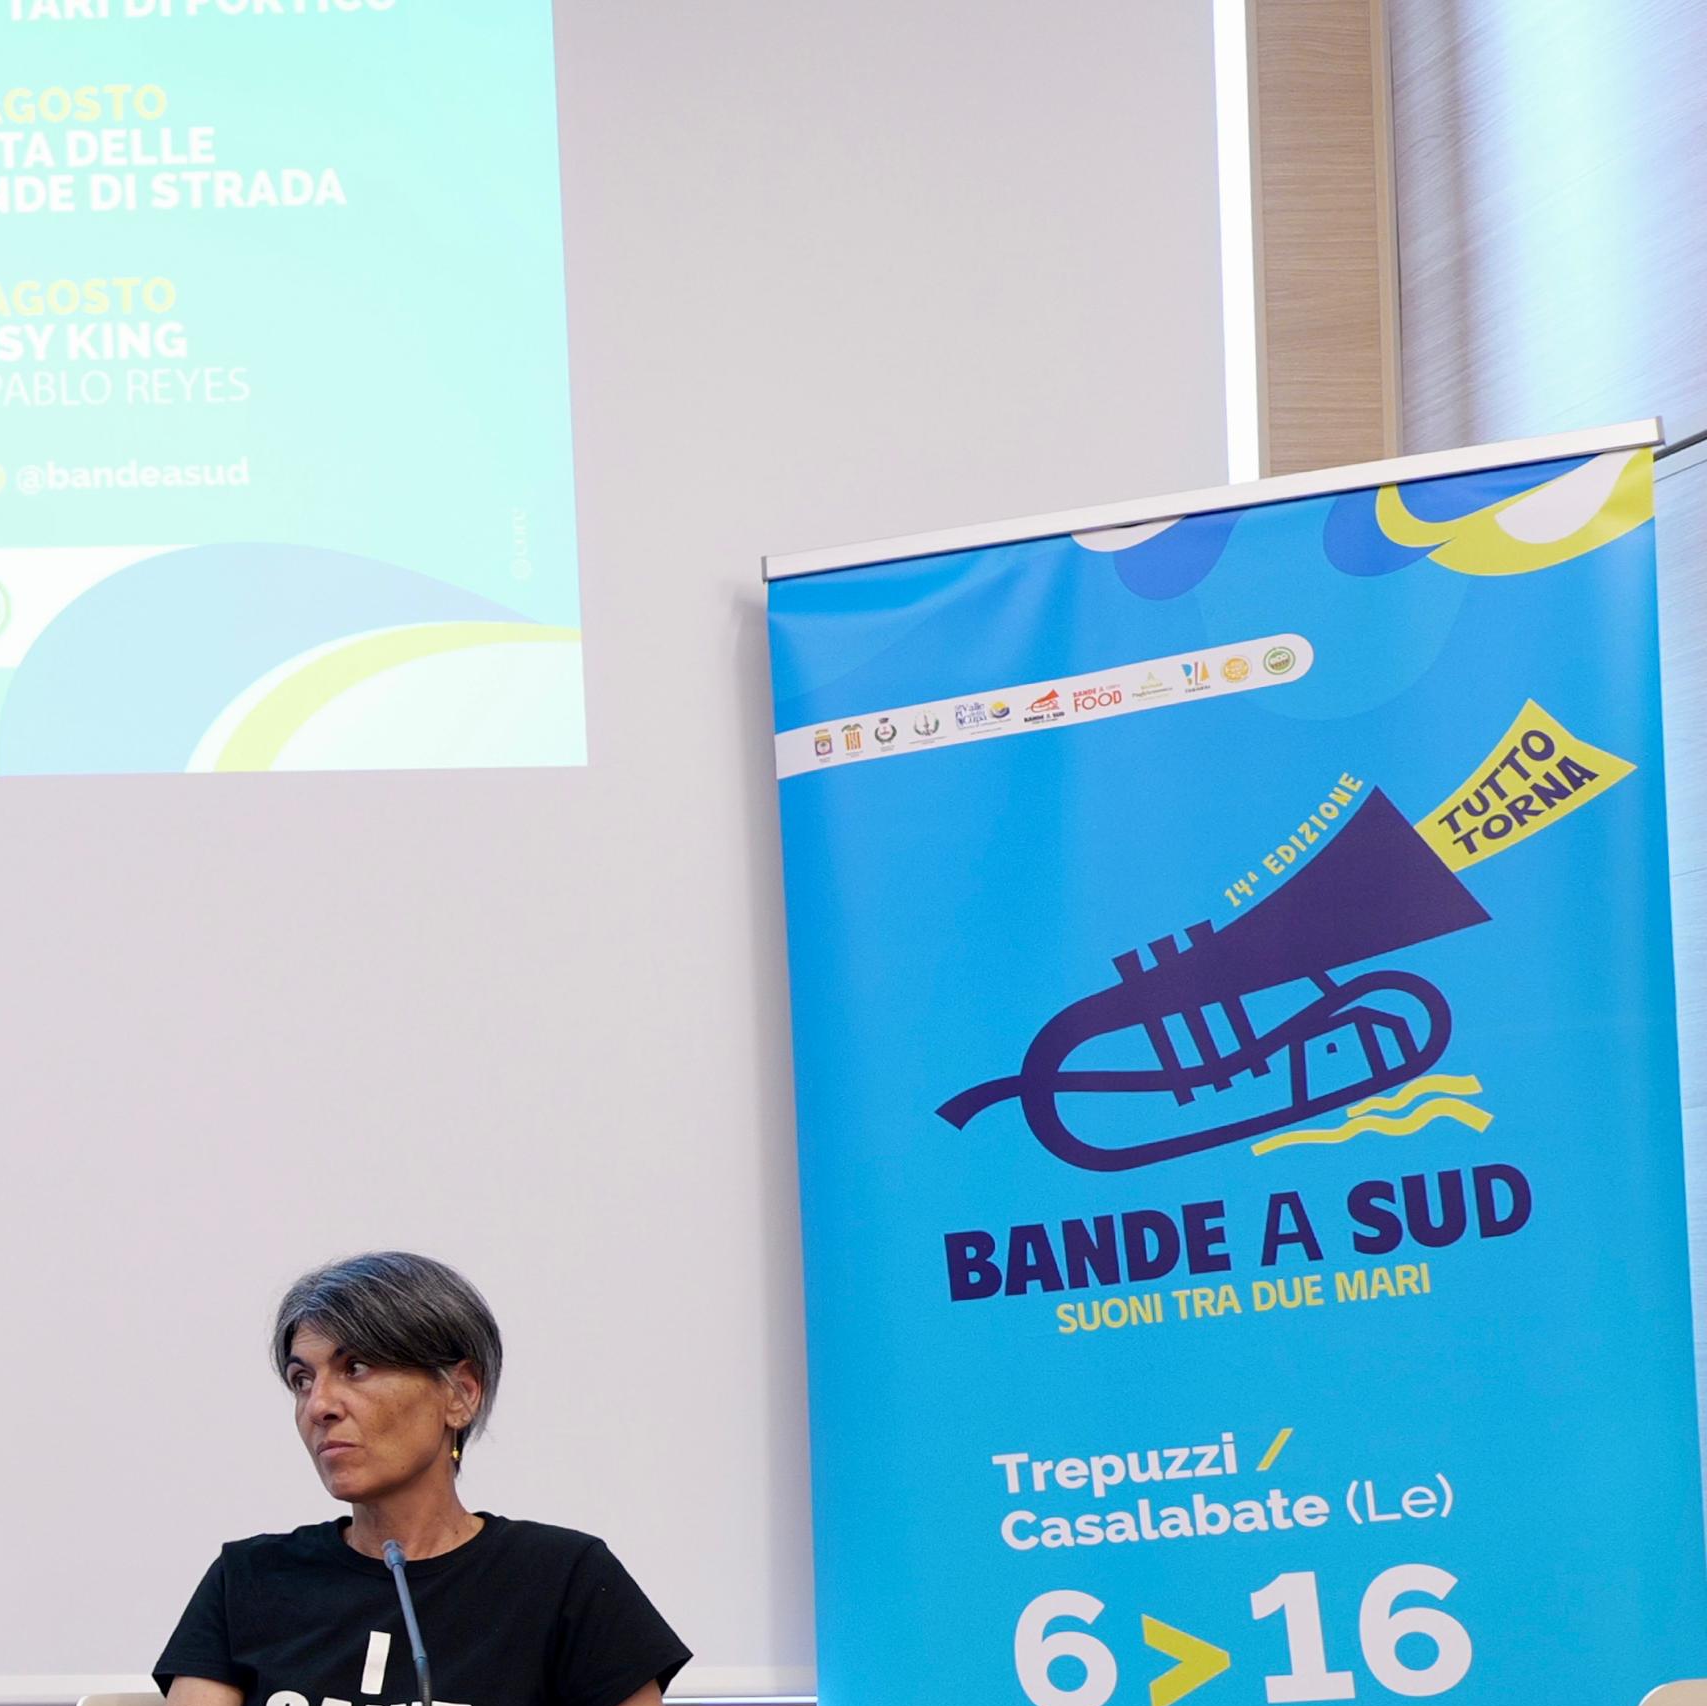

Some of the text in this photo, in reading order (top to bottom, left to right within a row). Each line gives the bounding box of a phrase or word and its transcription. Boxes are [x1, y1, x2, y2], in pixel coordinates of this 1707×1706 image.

[66, 126, 217, 168] DELLE
[89, 172, 136, 212] DI
[150, 167, 349, 210] STRADA
[66, 321, 189, 360] KING
[125, 366, 252, 406] REYES
[15, 456, 252, 495] @bandeasud
[1073, 690, 1123, 713] FOOD
[1438, 727, 1557, 838] TUTTO
[1452, 755, 1600, 856] TORNA
[1262, 769, 1366, 877] EDIZIONE
[943, 1161, 1534, 1303] BANDE A SUD
[1055, 1261, 1432, 1335] SUONI TRA DUE MARI
[991, 1431, 1237, 1501] Trepuzzi
[1000, 1472, 1455, 1553] Casalabate (Le)
[360, 1630, 391, 1695] I
[1248, 1562, 1475, 1706] 16
